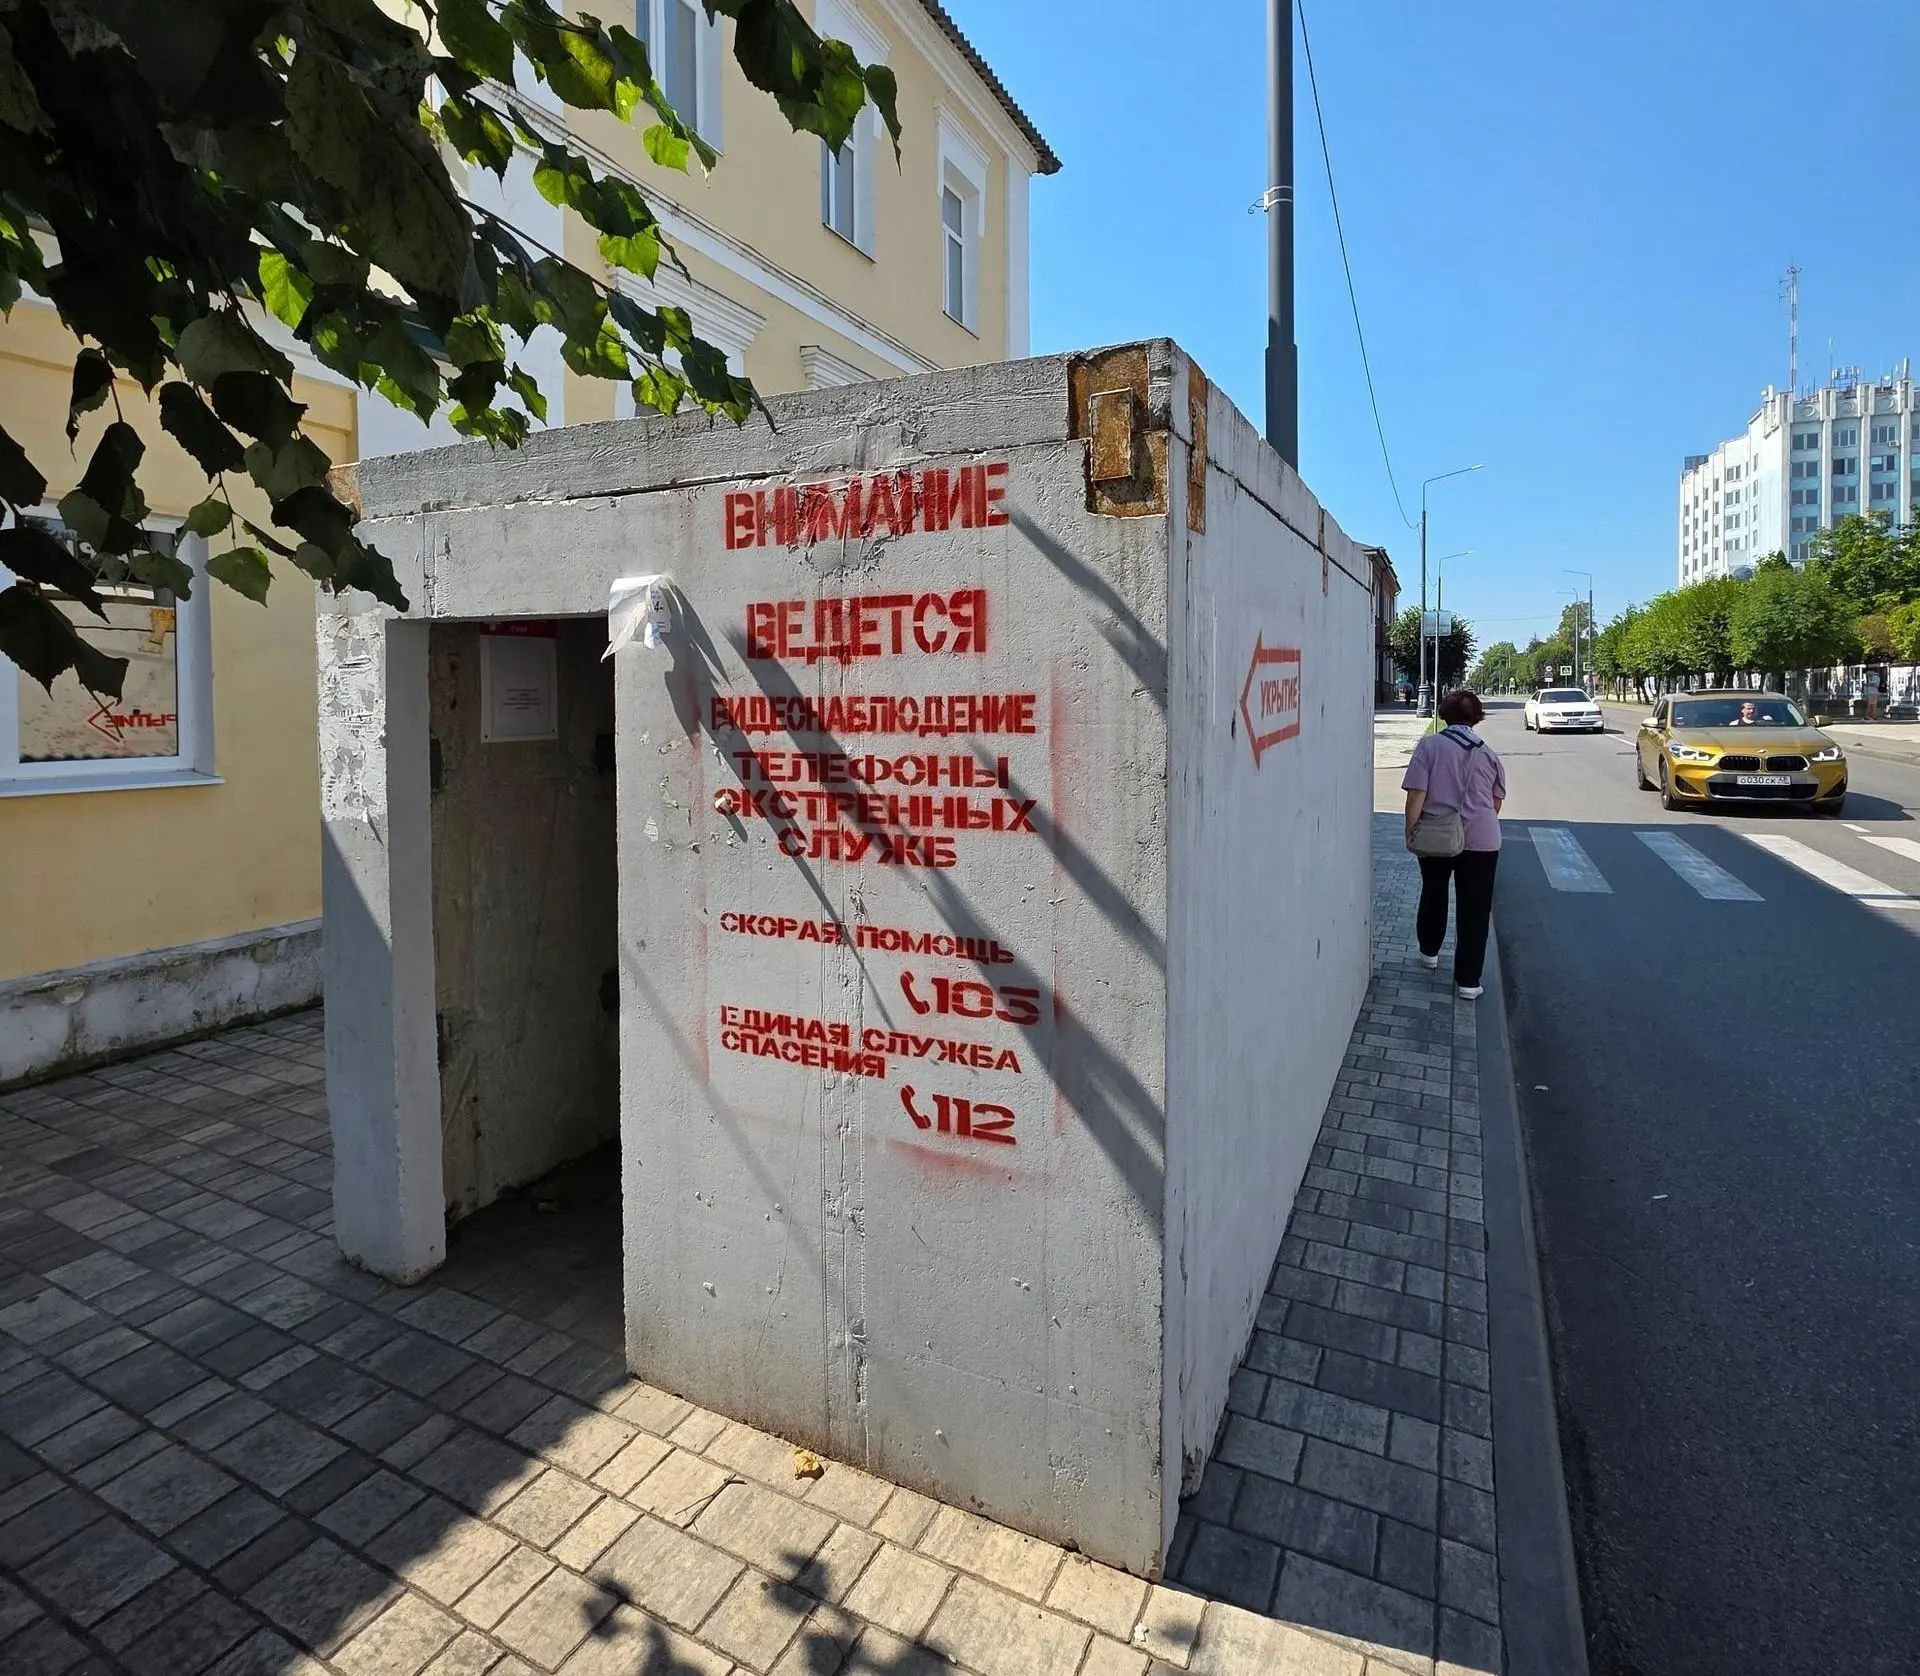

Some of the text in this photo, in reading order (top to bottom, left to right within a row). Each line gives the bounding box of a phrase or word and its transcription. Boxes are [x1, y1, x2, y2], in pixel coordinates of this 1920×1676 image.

[725, 462, 1009, 550] ВНИМАНИЕ
[747, 589, 987, 666] ВЕДЕТСЯ
[711, 694, 1036, 738] ВИДЕОНАБЛЮДЕНИЕ
[1260, 675, 1298, 721] УКРЫТИЕ
[732, 751, 1009, 790] ТЕЛЕФОНЫ
[713, 788, 1038, 833] ЭКСТРЕННЫХ
[778, 827, 958, 868] СЛУЖБ
[720, 912, 1015, 965] СКОРАЯ ПОМОЩЬ
[720, 1004, 1023, 1074] ЕДИНАЯ СЛУЖБА
[720, 1030, 886, 1079] СПАСЕНИЯ
[931, 1093, 1017, 1146] 112
